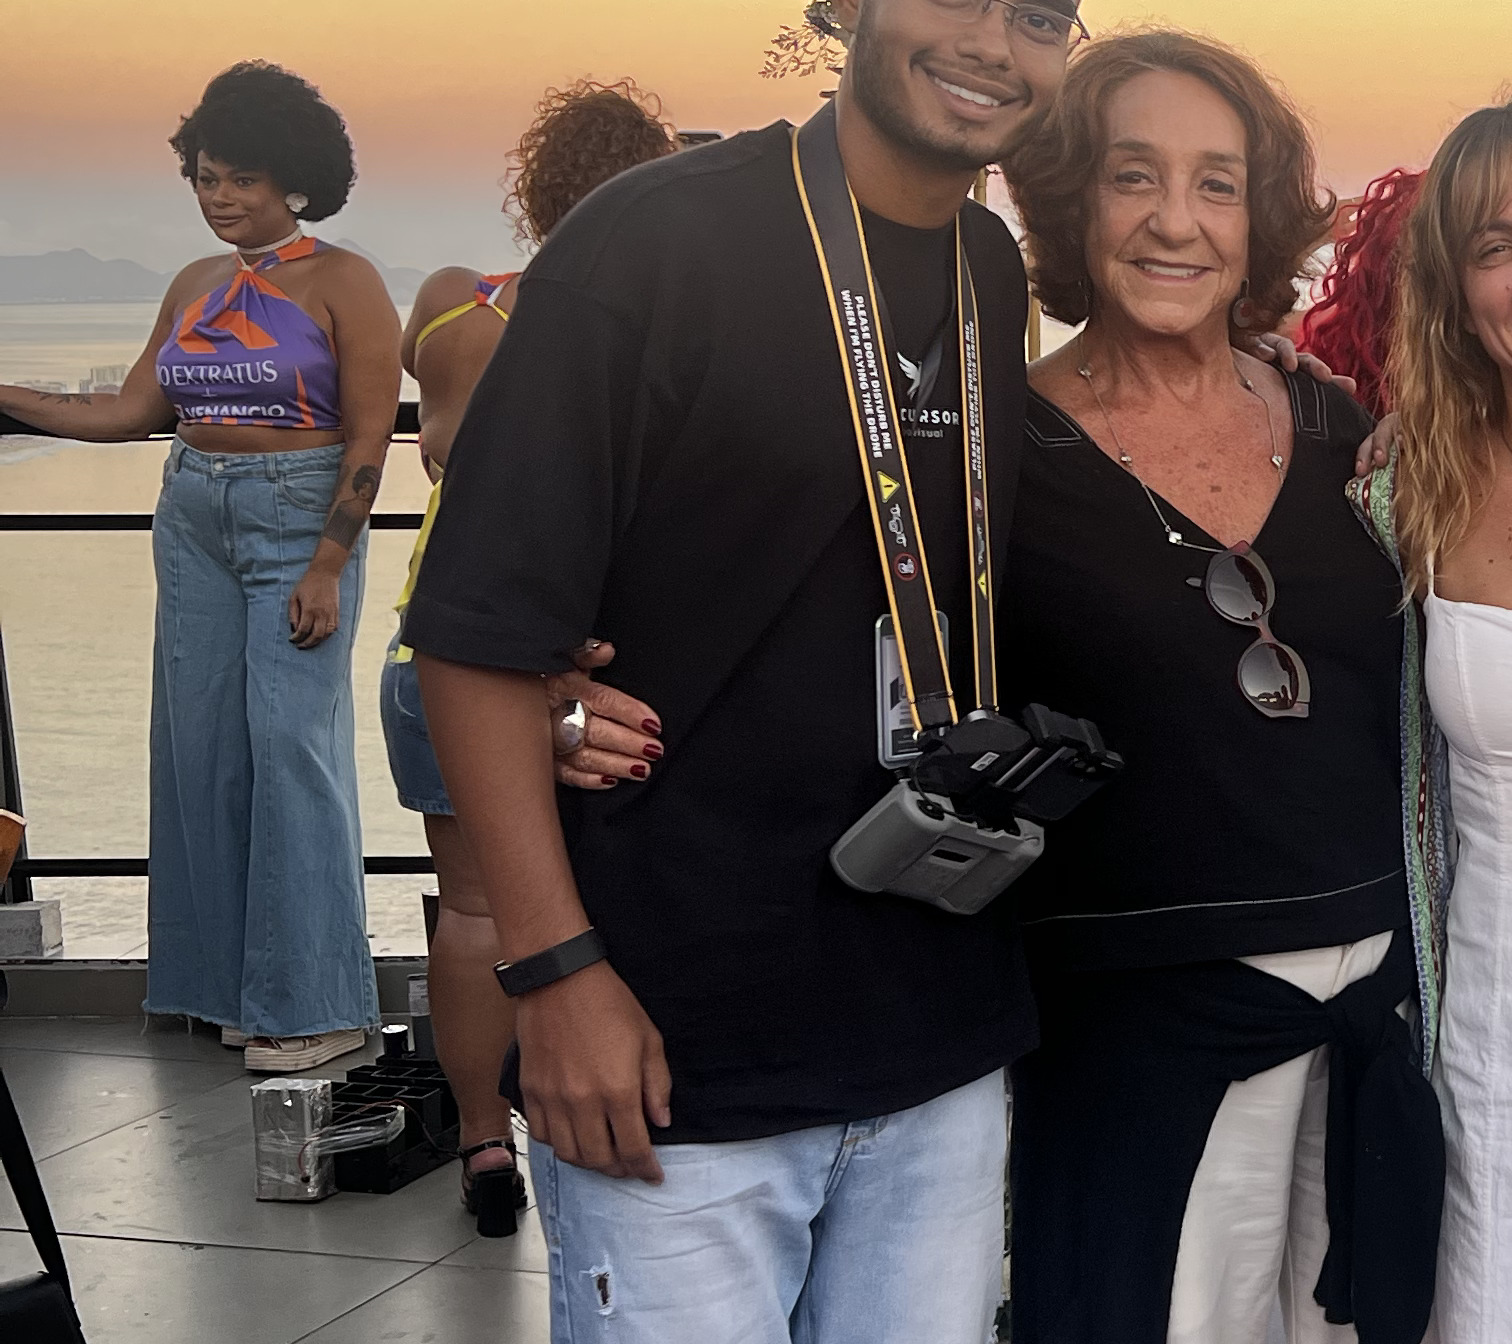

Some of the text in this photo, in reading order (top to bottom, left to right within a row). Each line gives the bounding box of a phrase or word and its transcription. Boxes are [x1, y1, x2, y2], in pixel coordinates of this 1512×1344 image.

[840, 289, 856, 326] WHEN
[158, 360, 279, 386] OEXTRATUS
[853, 348, 869, 390] FLYING
[855, 295, 892, 450] PLEASE DON'T DISTURB ME
[862, 392, 875, 416] THE
[900, 407, 960, 426] CURSOR
[866, 417, 883, 458] DRONE
